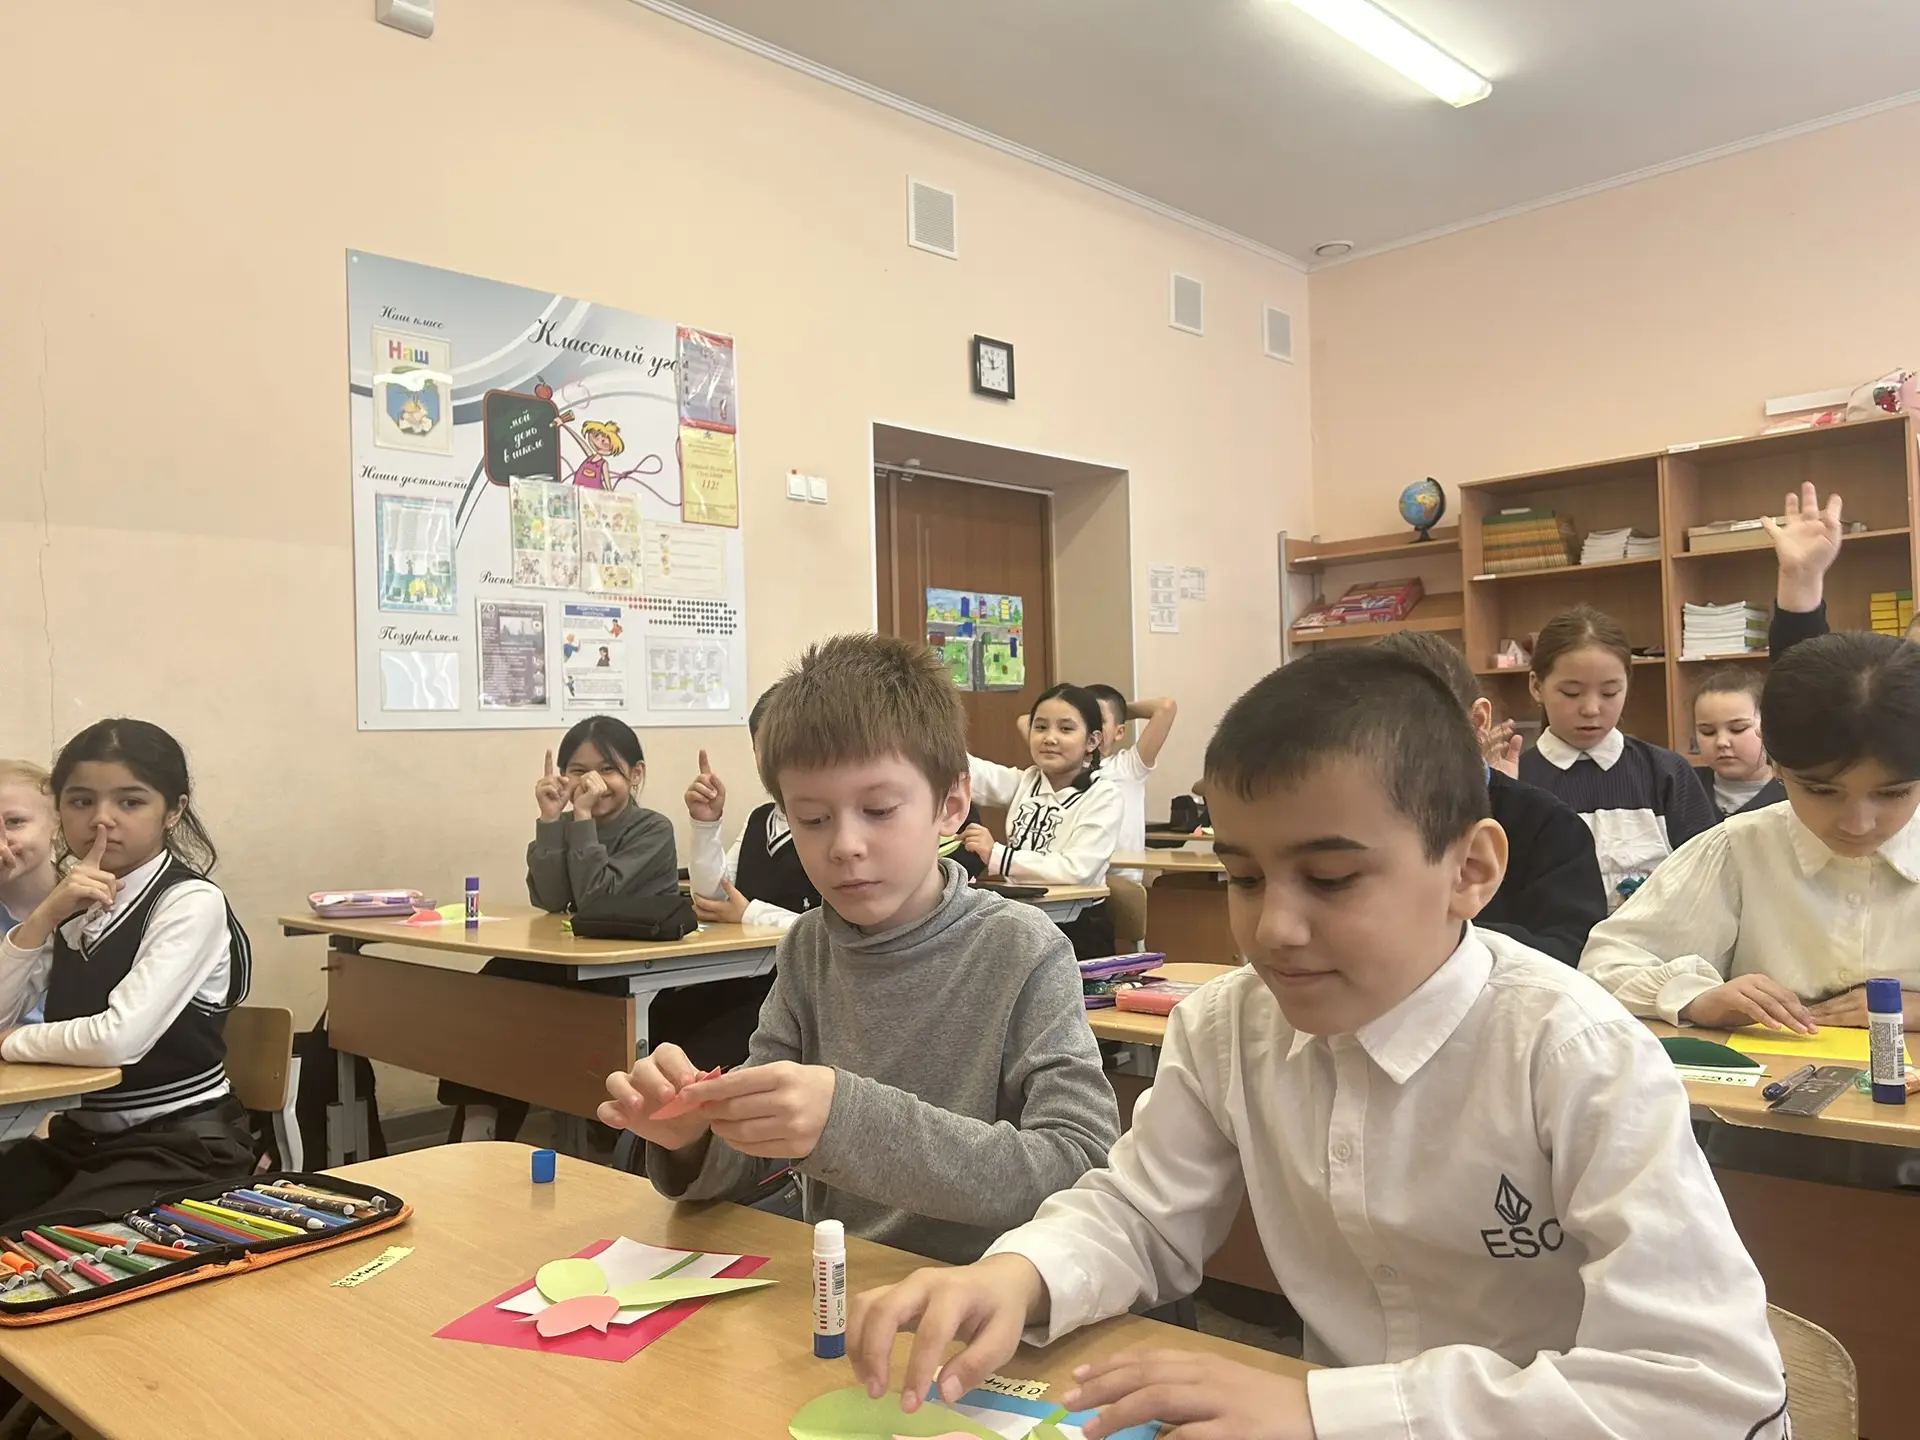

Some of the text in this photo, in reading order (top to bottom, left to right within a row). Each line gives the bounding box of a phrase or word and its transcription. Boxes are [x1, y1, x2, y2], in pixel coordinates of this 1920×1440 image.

[380, 305, 444, 328] Наш класс
[389, 339, 429, 365] Наш
[527, 318, 645, 365] Классный
[509, 409, 531, 429] мой
[513, 427, 538, 449] день
[503, 438, 544, 464] в школе
[359, 464, 473, 489] Наши достижени
[378, 625, 459, 646] Поздравляем
